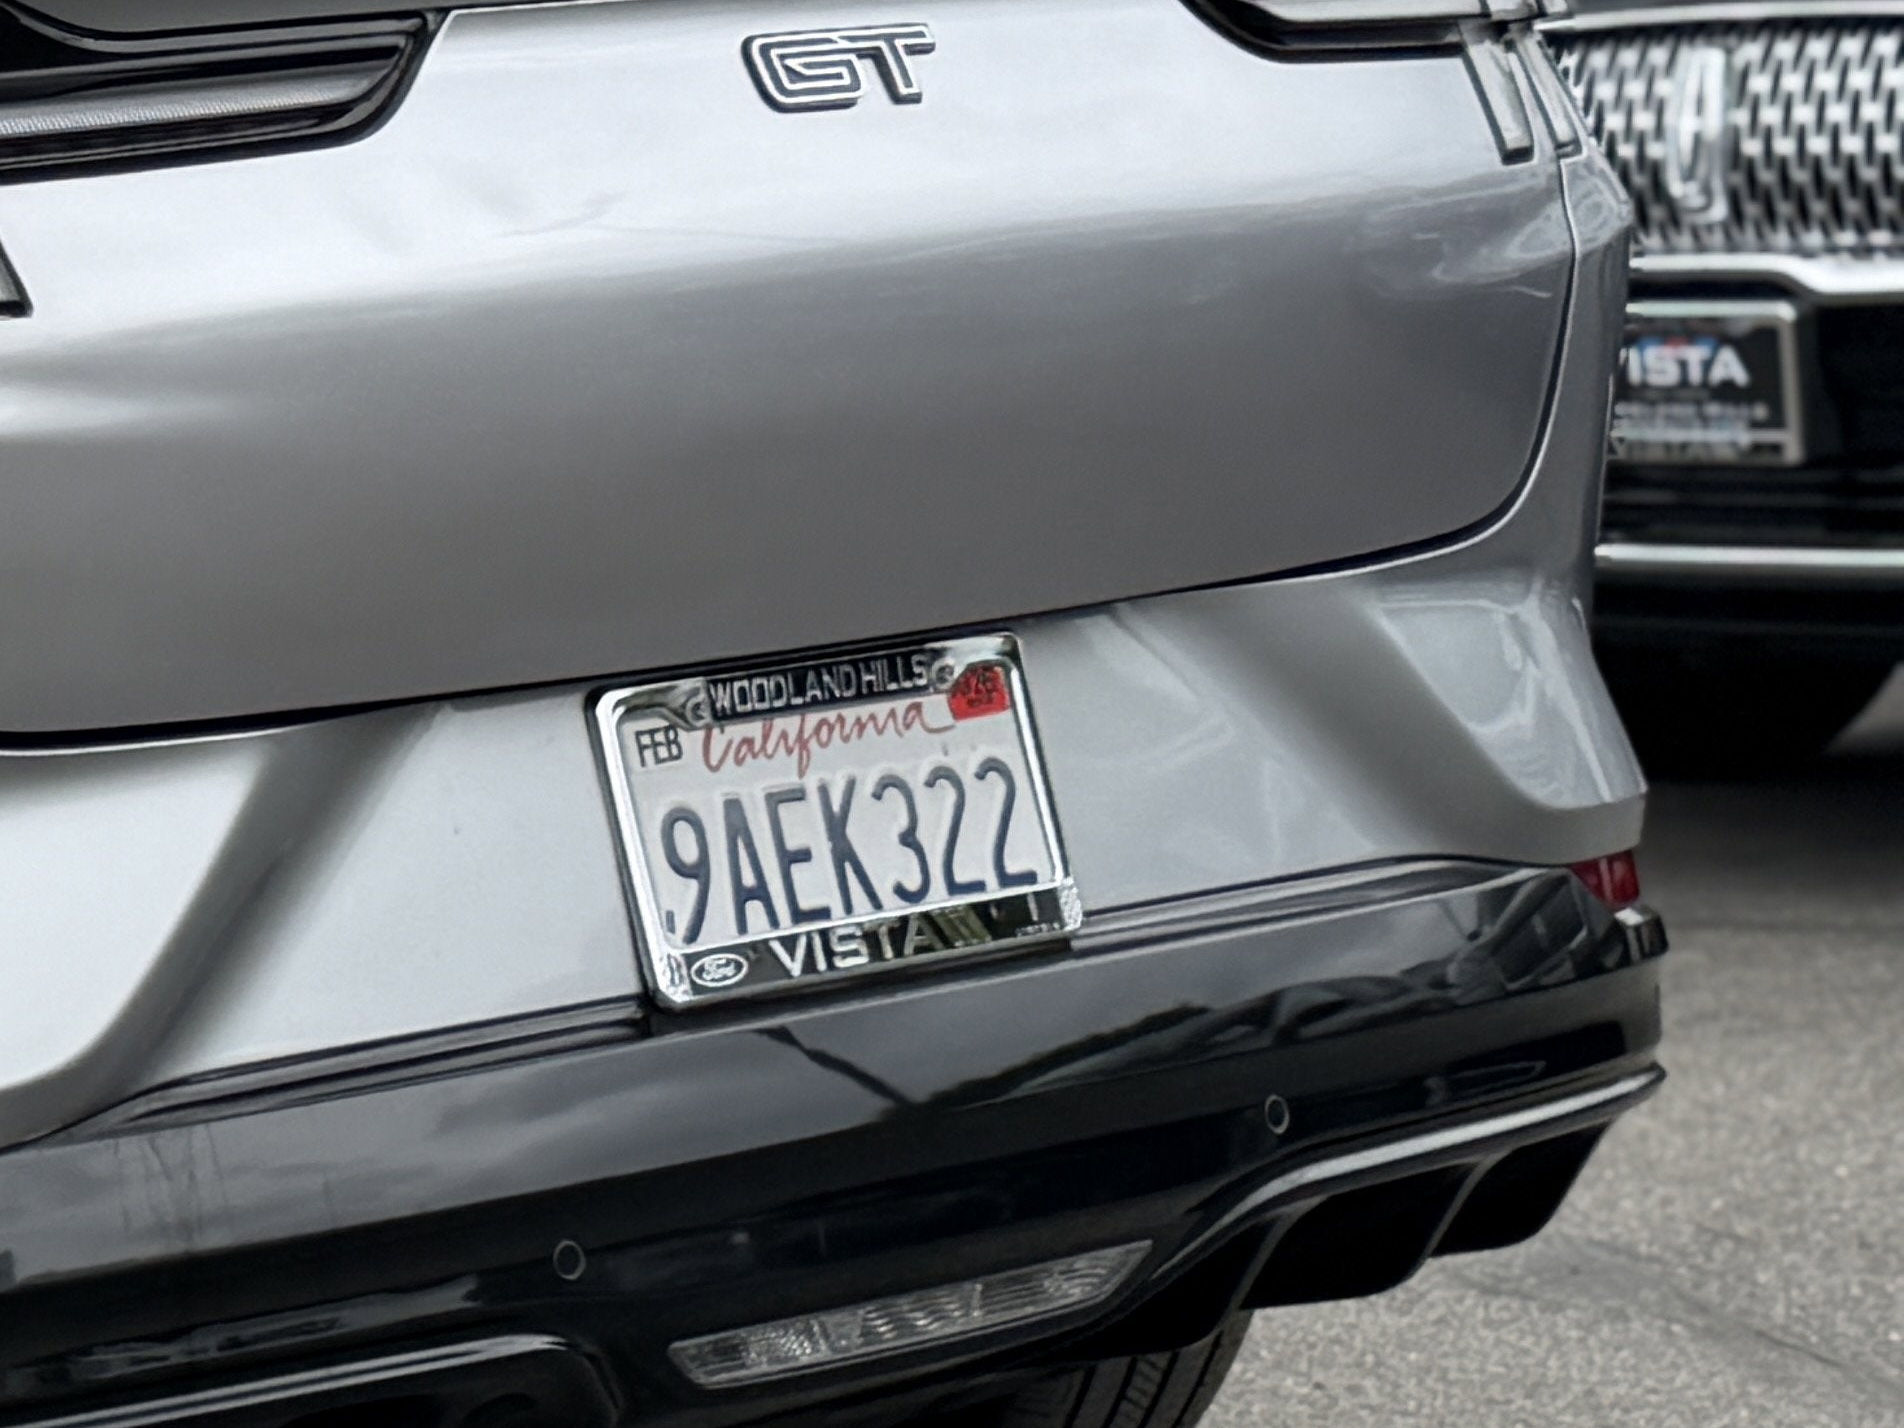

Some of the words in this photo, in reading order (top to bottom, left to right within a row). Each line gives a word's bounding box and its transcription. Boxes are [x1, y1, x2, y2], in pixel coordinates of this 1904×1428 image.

[741, 22, 936, 113] GT
[1619, 344, 1750, 388] ISTA
[709, 664, 857, 715] WOODLAND
[858, 653, 928, 695] HILLS
[635, 723, 683, 768] FEB
[702, 700, 956, 780] California
[660, 755, 1038, 946] 9AEK322
[767, 910, 948, 978] VISTA
